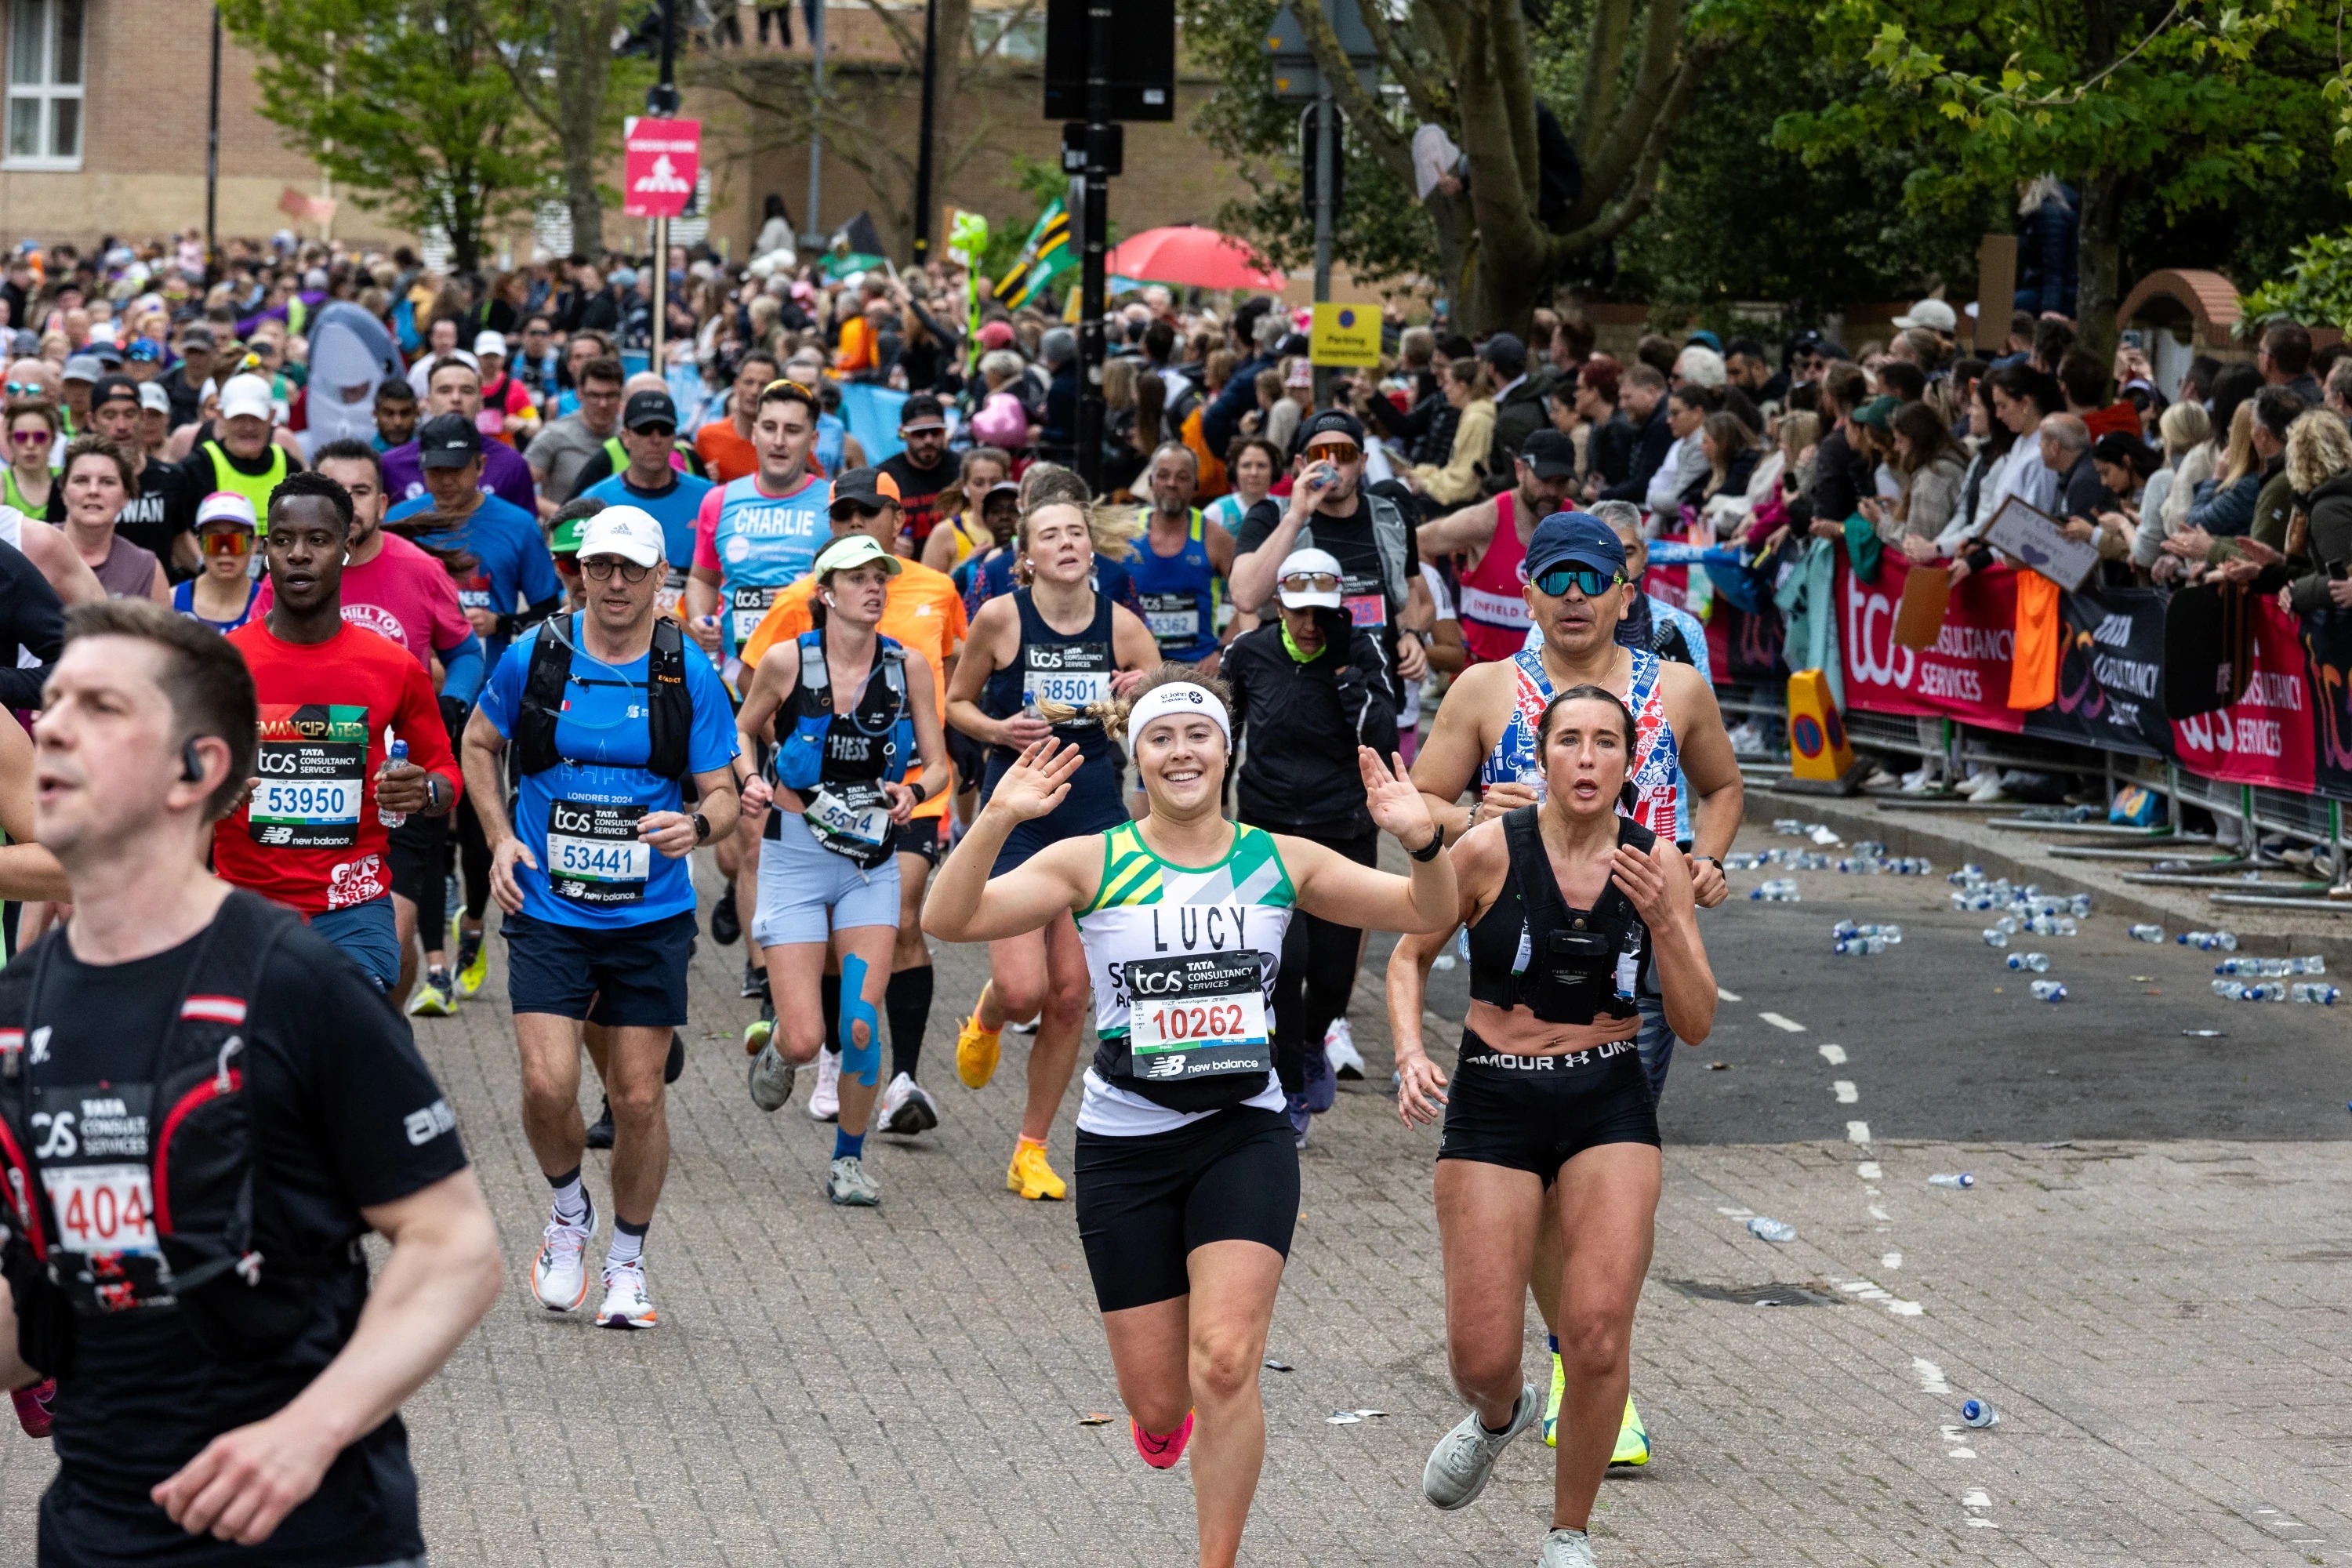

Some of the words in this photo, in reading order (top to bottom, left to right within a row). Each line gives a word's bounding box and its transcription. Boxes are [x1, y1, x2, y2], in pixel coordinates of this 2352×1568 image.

[114, 498, 164, 523] WAN
[734, 507, 815, 536] CHARLIE
[735, 589, 760, 608] tcs
[1346, 603, 1374, 621] 25
[1474, 600, 1519, 618] ENFIELD
[340, 607, 372, 620] HILL
[376, 611, 401, 638] TOP
[1030, 649, 1062, 668] tcs
[1918, 661, 1982, 702] SERVICES
[2236, 717, 2282, 758] SERVICES
[258, 748, 296, 773] tcs
[567, 792, 610, 803] LONDRES
[612, 795, 633, 804] 2024
[846, 785, 867, 793] TATA
[268, 787, 344, 814] 53950
[554, 805, 590, 833] tcs
[594, 818, 640, 827] CONSULTANC
[595, 810, 619, 818] TATA
[292, 837, 313, 846] new
[314, 836, 350, 845] balance
[822, 840, 840, 851] new
[838, 845, 869, 859] balance
[563, 844, 632, 873] 53441
[602, 891, 636, 902] balance
[1153, 906, 1245, 952] LUCY
[1186, 960, 1215, 971] TATA
[1187, 967, 1253, 982] CONSULTANCY
[1135, 967, 1182, 994] tcs
[1187, 980, 1229, 991] SERVICES
[1153, 1004, 1245, 1040] 10262
[1188, 1062, 1210, 1073] new
[1212, 1059, 1258, 1070] balance
[81, 1098, 127, 1117] TATA
[49, 1185, 146, 1240] 404
